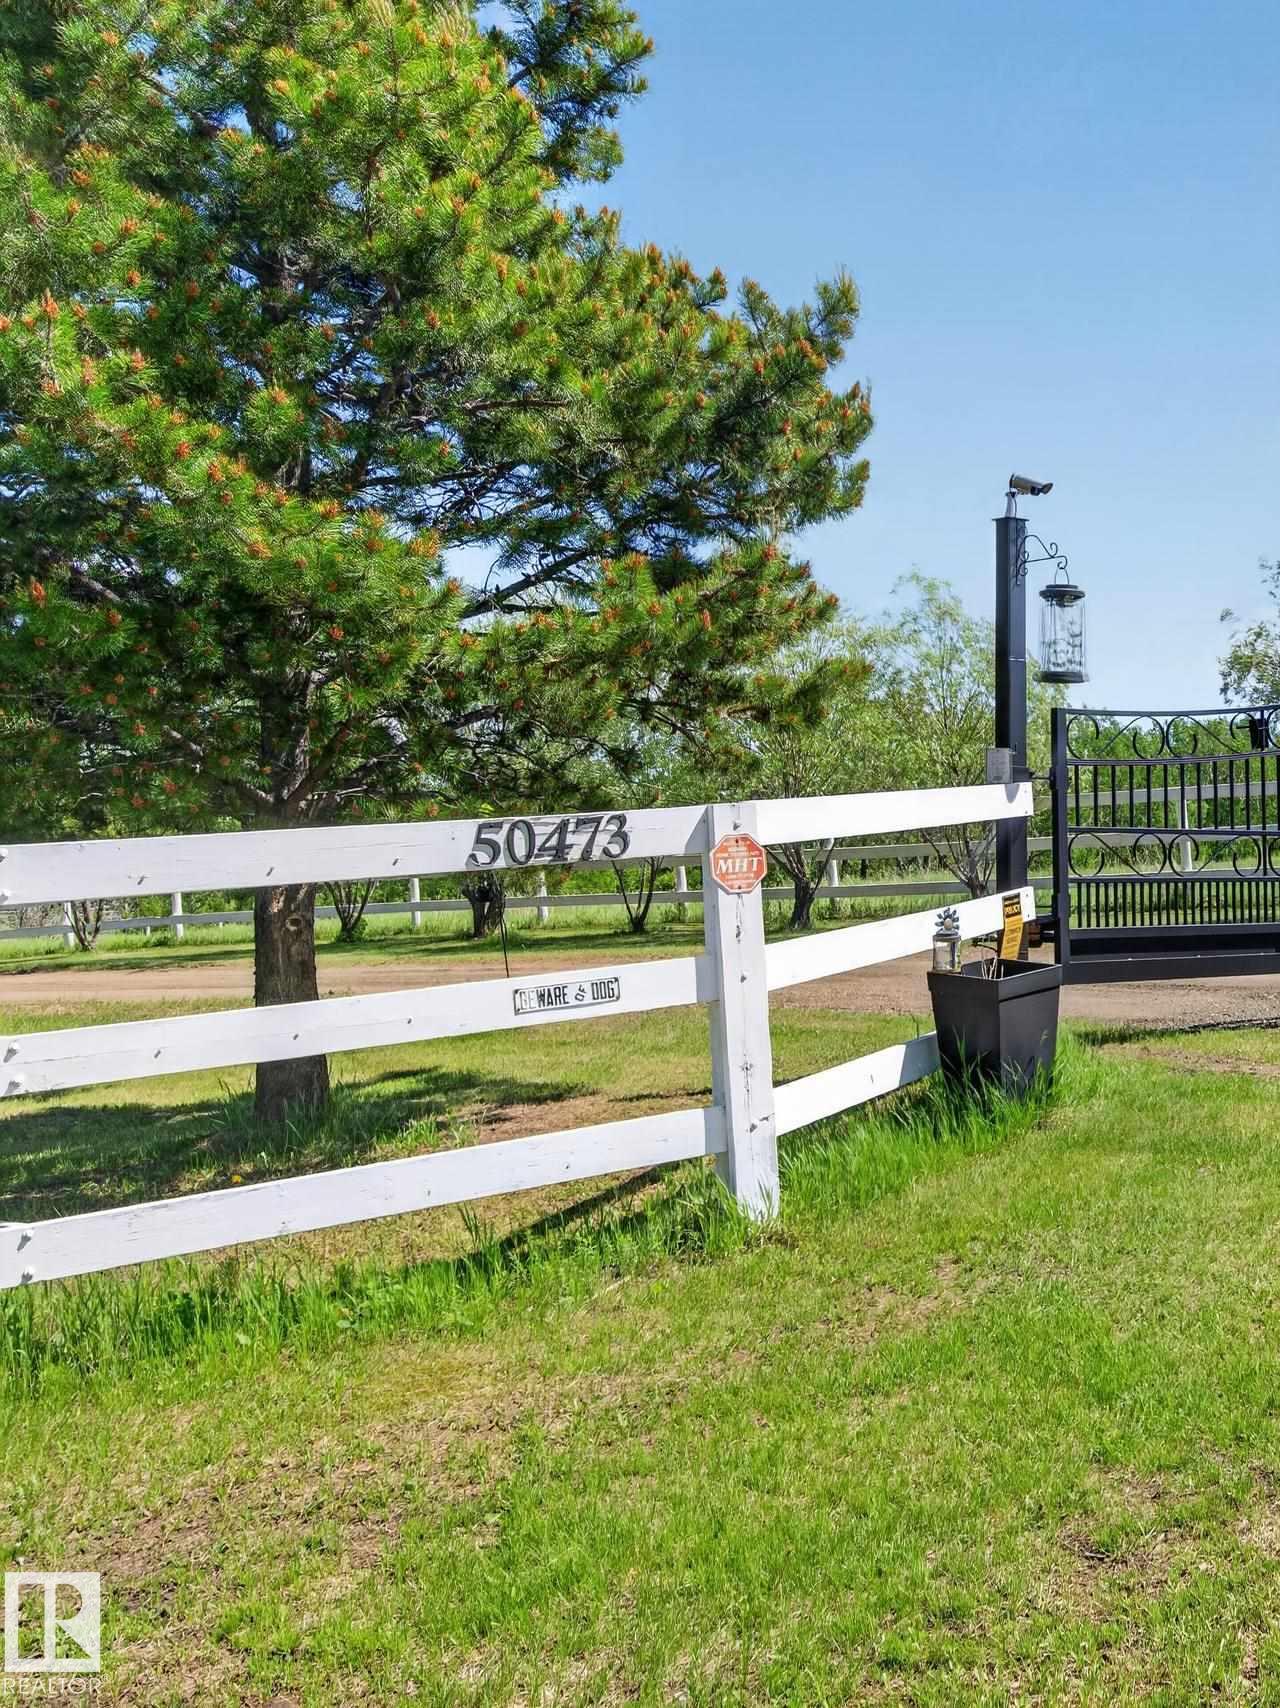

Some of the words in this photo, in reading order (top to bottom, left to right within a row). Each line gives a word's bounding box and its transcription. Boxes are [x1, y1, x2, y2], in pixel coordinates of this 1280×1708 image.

[467, 813, 630, 867] 50473
[574, 985, 587, 1001] OF
[591, 981, 616, 1000] DOG
